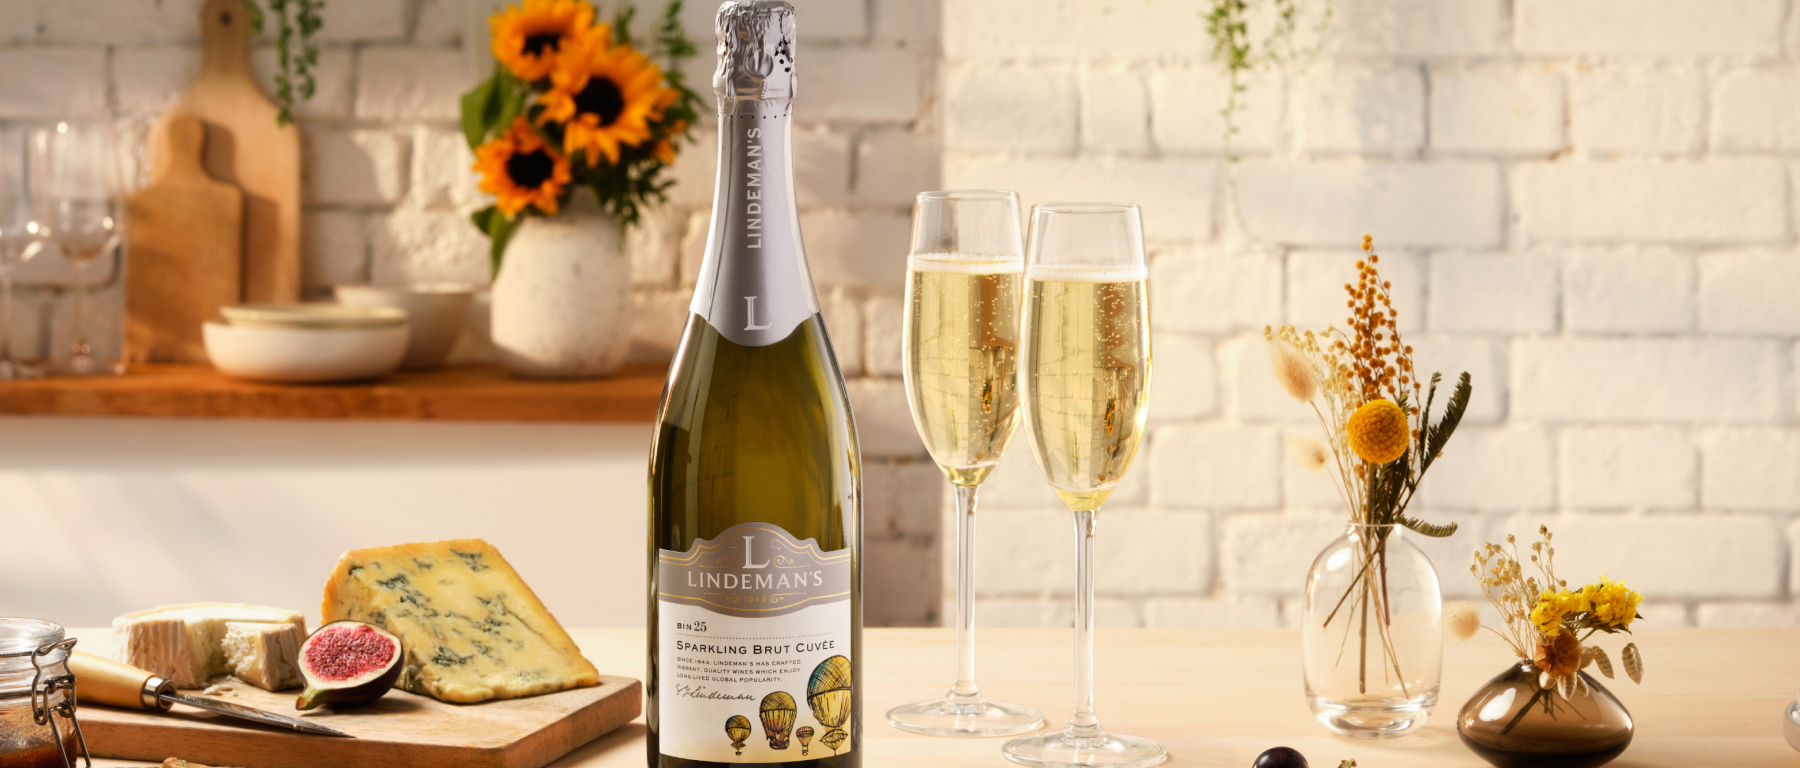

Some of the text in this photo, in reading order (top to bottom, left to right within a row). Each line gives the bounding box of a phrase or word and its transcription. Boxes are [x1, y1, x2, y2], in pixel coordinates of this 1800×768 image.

[747, 127, 762, 249] LINDEMAN'S
[744, 296, 773, 331] L
[742, 536, 770, 569] L
[687, 570, 823, 590] LINDEMAN'S
[744, 595, 767, 603] 1843
[677, 620, 707, 632] BIN 25
[676, 656, 693, 664] SINCE
[703, 667, 731, 675] QUALITY
